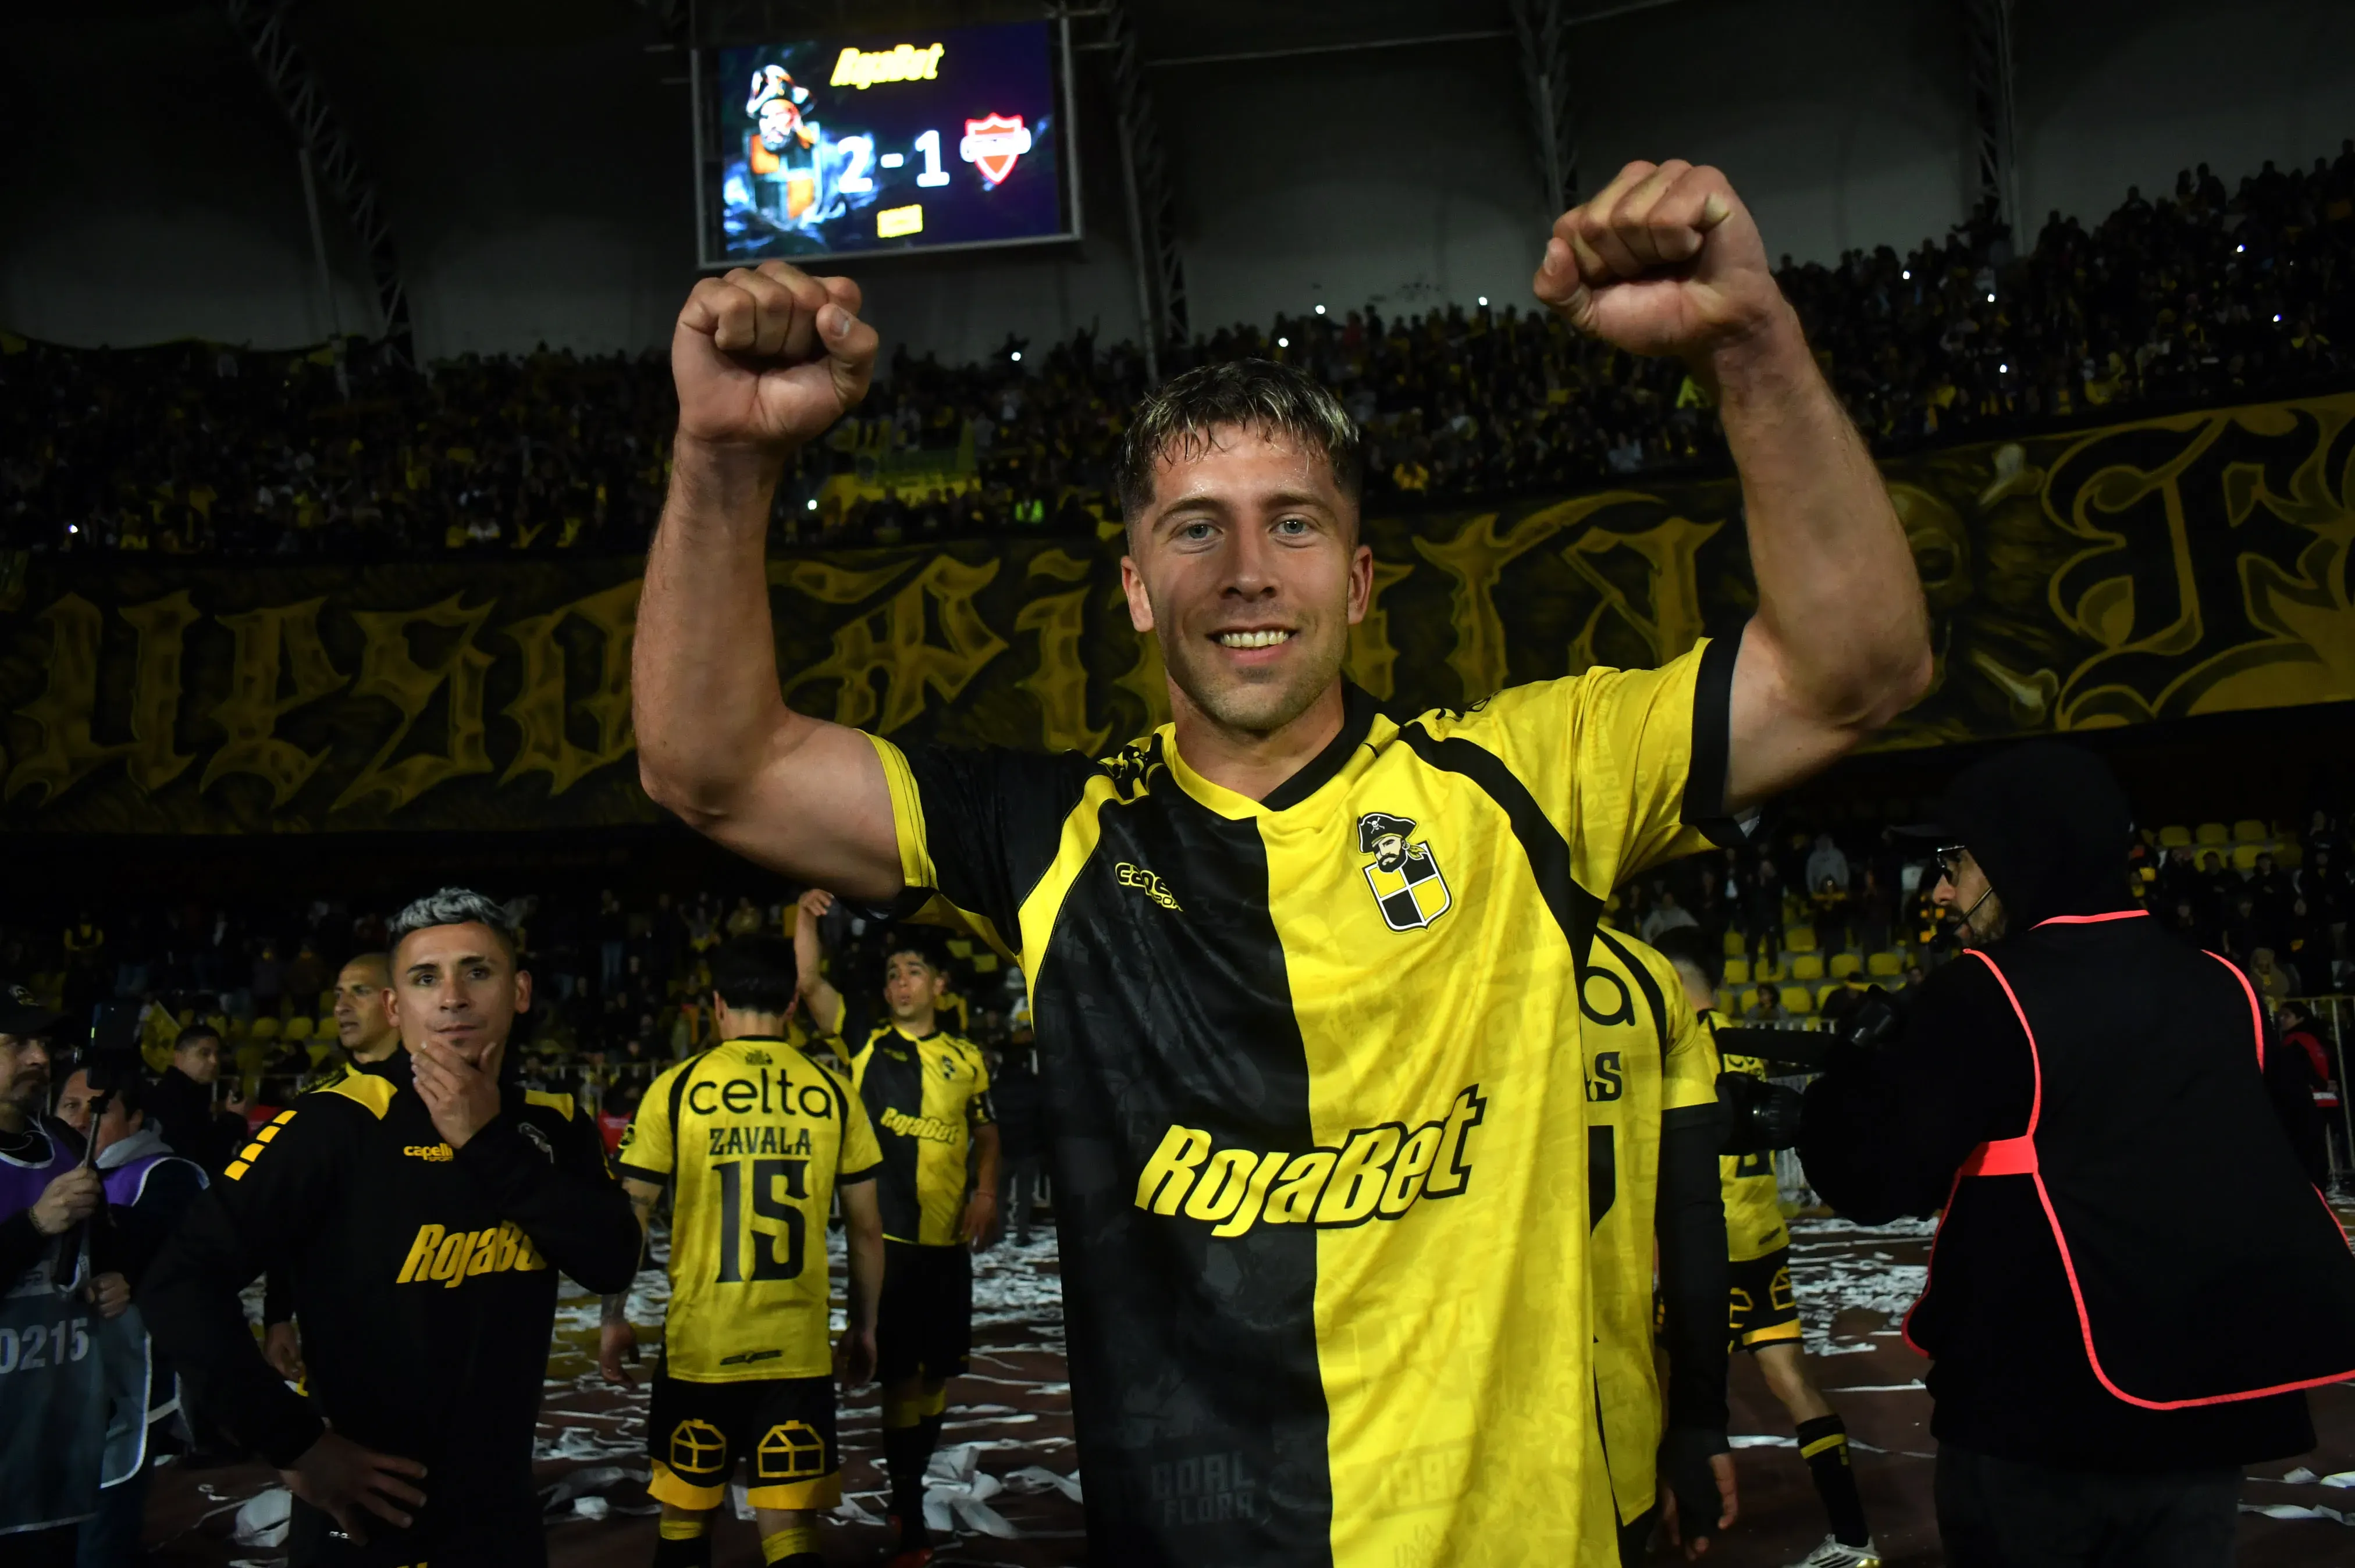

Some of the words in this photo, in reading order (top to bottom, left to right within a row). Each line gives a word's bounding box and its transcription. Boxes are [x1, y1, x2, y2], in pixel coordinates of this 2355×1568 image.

[830, 42, 944, 90] RojaBet
[837, 136, 874, 194] 2
[915, 130, 950, 188] 1
[688, 1068, 832, 1120] celta
[709, 1126, 812, 1156] ZAVALA
[879, 1106, 959, 1144] RojaBet
[1134, 1083, 1487, 1238] RojaBet
[712, 1159, 810, 1283] 15
[0, 1317, 90, 1374] 0215
